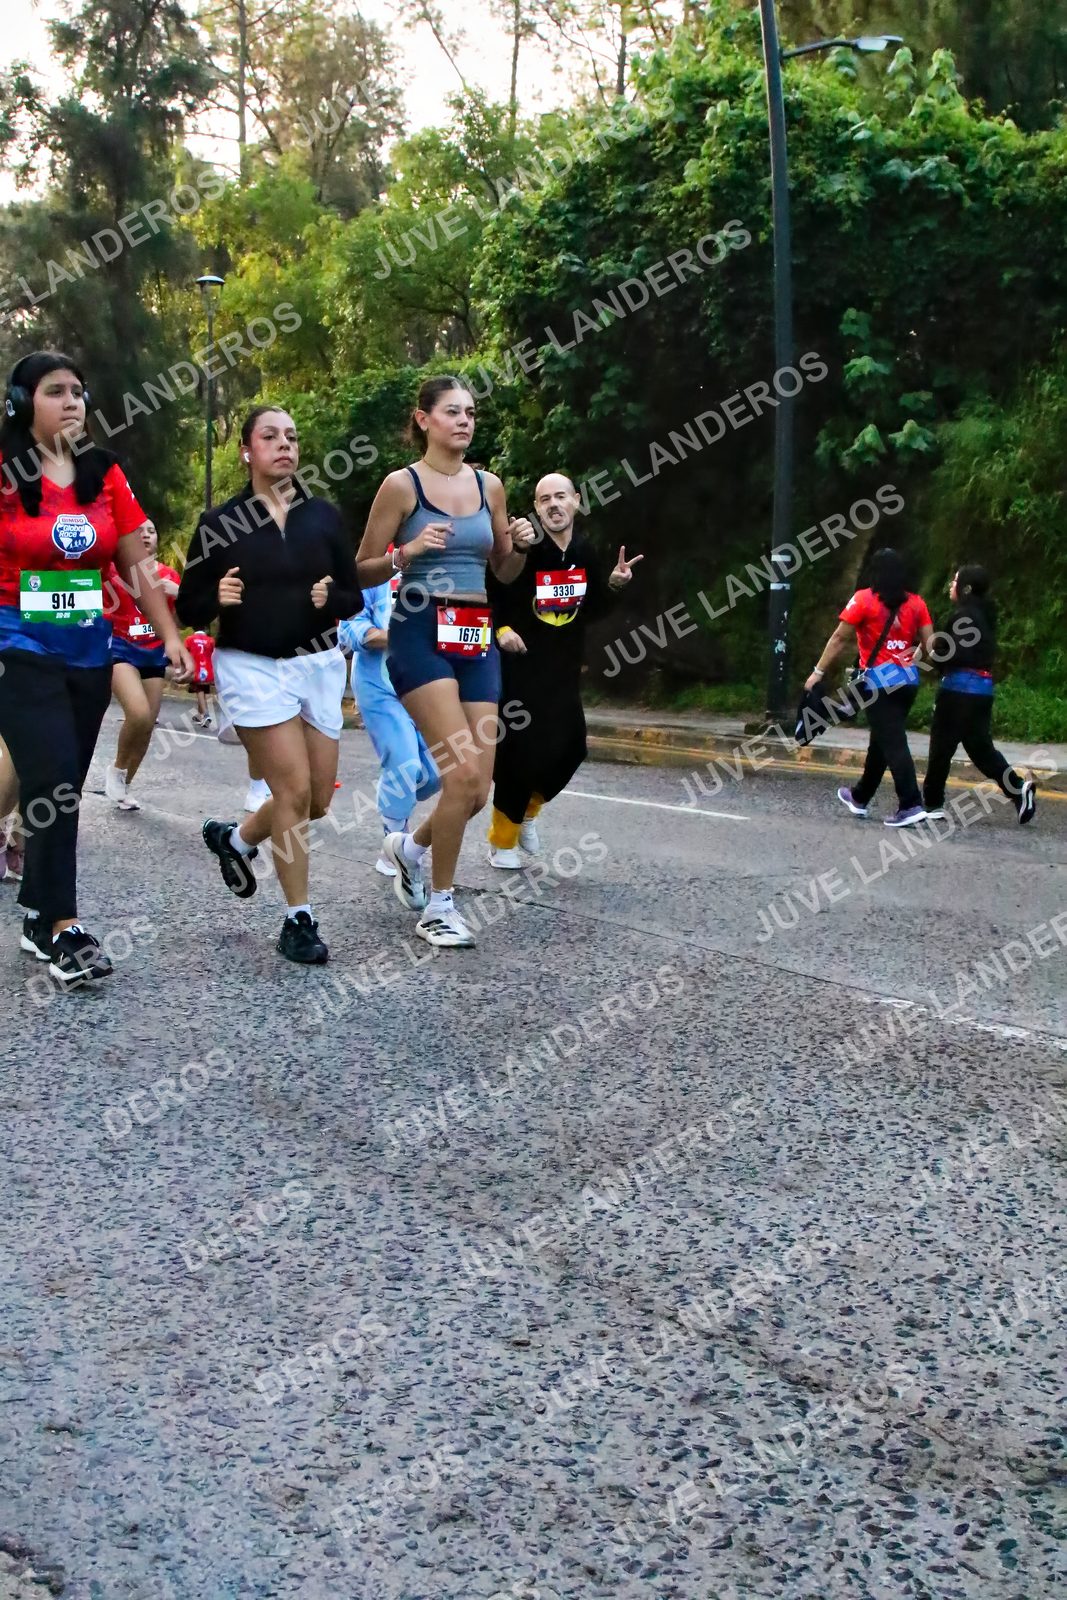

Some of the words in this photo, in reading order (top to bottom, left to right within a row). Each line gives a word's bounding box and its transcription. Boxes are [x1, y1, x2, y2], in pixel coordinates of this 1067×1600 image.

[553, 585, 575, 597] 3330
[52, 593, 75, 609] 914
[142, 624, 154, 633] 34
[459, 627, 480, 642] 1675
